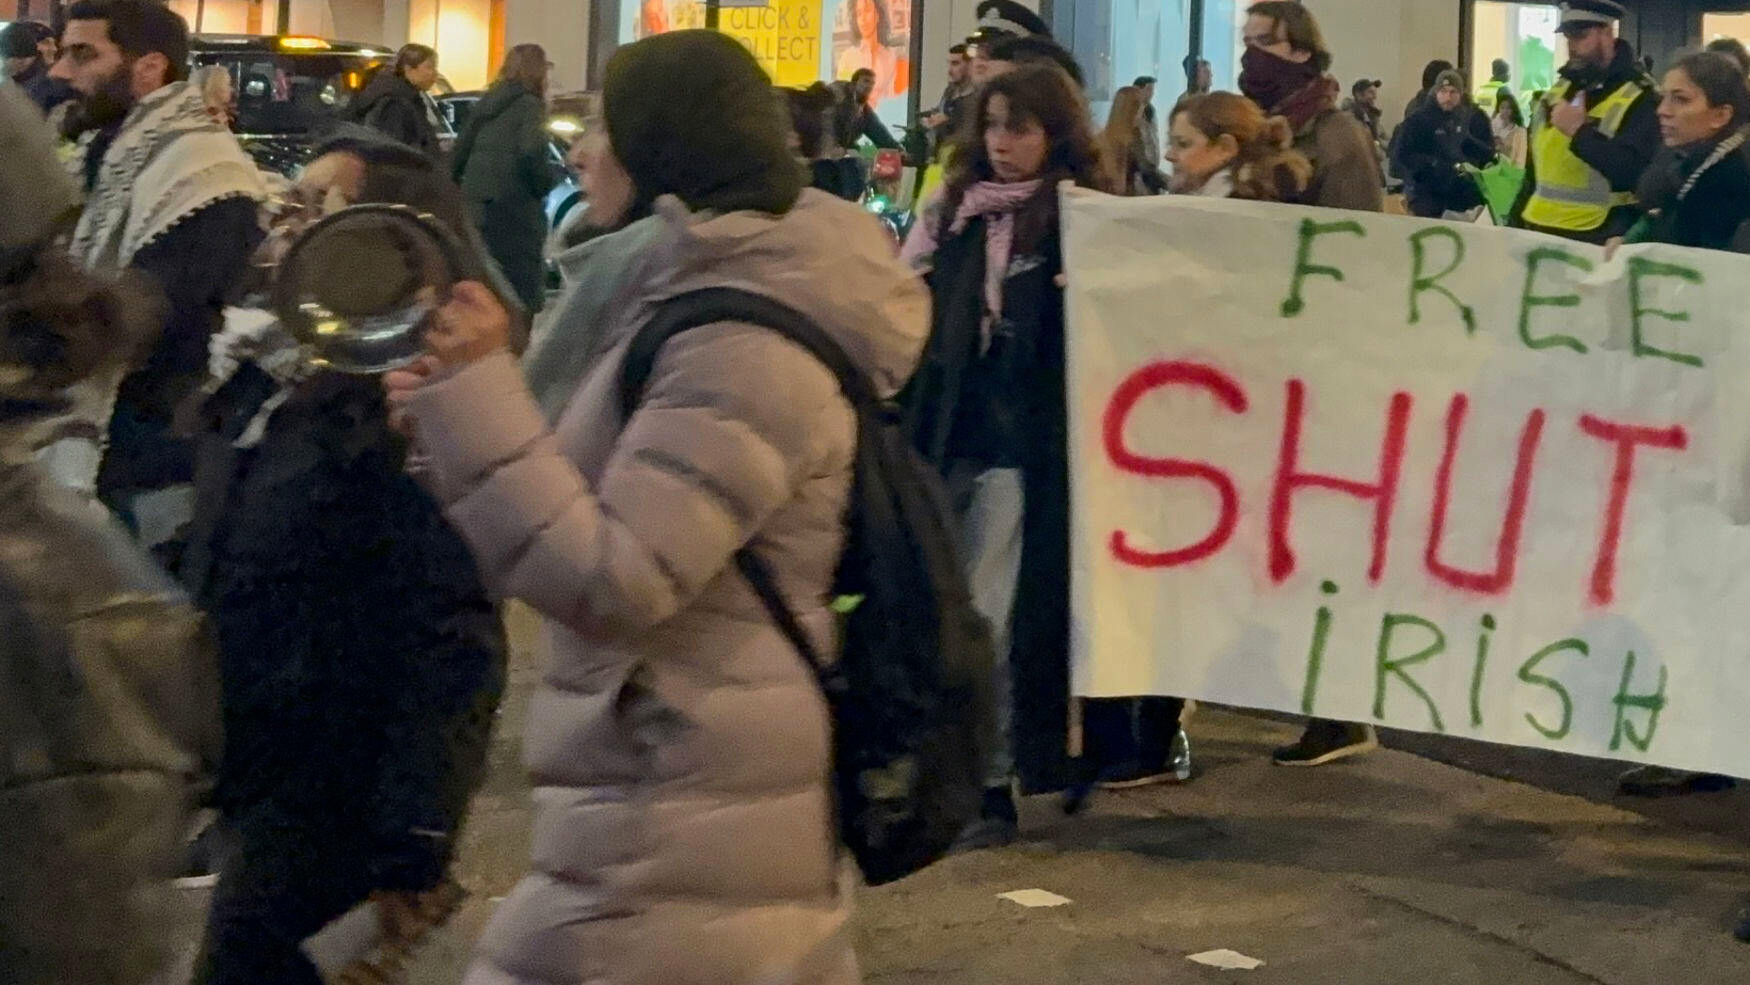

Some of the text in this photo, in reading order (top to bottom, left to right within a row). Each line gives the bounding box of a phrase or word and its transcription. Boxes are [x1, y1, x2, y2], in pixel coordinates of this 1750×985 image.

[730, 5, 810, 31] CLICK &
[1280, 218, 1704, 368] FREE
[1101, 358, 1688, 607] SHUT
